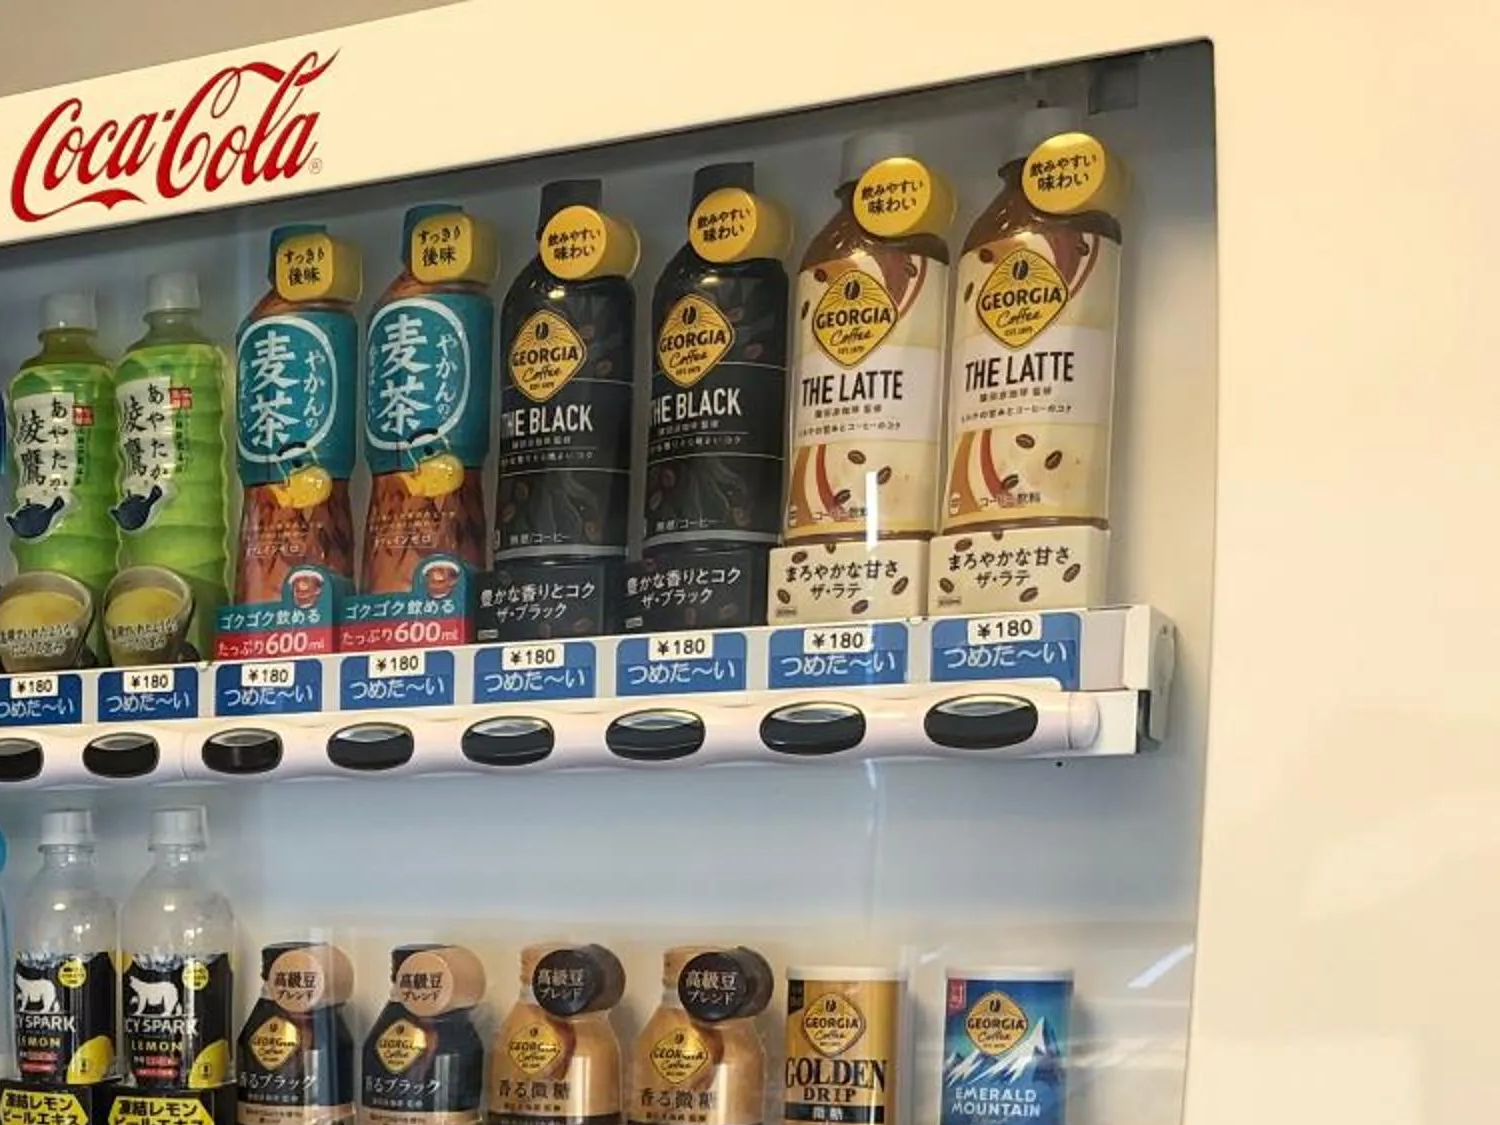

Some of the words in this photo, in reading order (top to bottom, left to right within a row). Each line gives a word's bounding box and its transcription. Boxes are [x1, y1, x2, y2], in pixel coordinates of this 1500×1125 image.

[11, 47, 341, 222] Coca-Cola
[1030, 154, 1097, 177] 飲みやすい
[861, 180, 924, 199] 飲みやすい
[1038, 172, 1090, 193] 味わい
[867, 196, 917, 215] 味わい
[697, 209, 751, 228] 飲みやすい
[418, 225, 461, 246] すっきり
[547, 229, 600, 246] 飲みやすい
[703, 225, 744, 242] 味わい
[283, 246, 325, 265] すっきり
[422, 247, 456, 267] 後味
[553, 245, 595, 261] 味わい
[288, 267, 320, 286] 後味
[981, 287, 1064, 311] GEORGIA
[816, 308, 892, 329] GEORGIA
[996, 308, 1043, 329] Coffee
[659, 329, 728, 352] GEORGIA
[512, 346, 578, 367] GEORGIA
[380, 313, 433, 435] 麦茶
[435, 334, 459, 416] やかんの
[964, 357, 1000, 392] THE
[1006, 351, 1074, 387] LATTE
[249, 330, 301, 449] 麦茶
[303, 350, 326, 430] やかんの
[802, 375, 833, 407] THE
[838, 370, 904, 401] LATTE
[675, 388, 742, 420] BLACK
[529, 404, 594, 434] BLACK
[121, 395, 148, 477] 綾鷹
[147, 382, 170, 482] あやたか
[19, 409, 47, 487] 綾鷹
[49, 397, 69, 492] あやたか
[948, 546, 1071, 571] まろやかな甘さ
[785, 560, 899, 583] まろやかな甘さ
[975, 571, 1030, 587] ザ・ラテ
[626, 568, 742, 597] 豊かな香りとコク
[810, 584, 862, 600] ザ・ラテ
[480, 583, 596, 608] 豊かな香りとコク
[641, 589, 713, 609] ザ・ブラック
[345, 600, 456, 620] ゴクゴク飲める
[496, 603, 567, 624] ザ・ブラック
[220, 610, 322, 631] ゴクゴク飲める
[977, 620, 1033, 638] ¥180
[657, 639, 705, 655] ¥180
[813, 633, 864, 649] ¥180
[375, 656, 419, 672] ¥180
[510, 649, 556, 665] ¥180
[130, 675, 169, 690] ¥180
[248, 668, 289, 683] ¥180
[17, 679, 53, 694] ¥180
[274, 971, 317, 989] 高級豆
[400, 972, 443, 989] 高級豆
[537, 968, 585, 988] 高級豆
[685, 971, 738, 992] 高級豆
[277, 989, 315, 1002] ブレンド
[402, 989, 441, 1003] ブレンド
[539, 988, 582, 1002] ブレンド
[688, 990, 735, 1004] ブレンド
[144, 1016, 200, 1037] SPARK
[805, 1016, 861, 1030] GEORGIA
[967, 1016, 1026, 1031] GEORGIA
[131, 1040, 183, 1052] LEMON
[785, 1057, 886, 1092] GOLDEN
[803, 1089, 857, 1102] DRIP
[955, 1087, 1036, 1102] EMERALD
[119, 1099, 198, 1118] 凍結レモン
[951, 1101, 1041, 1117] MOUNTAIN
